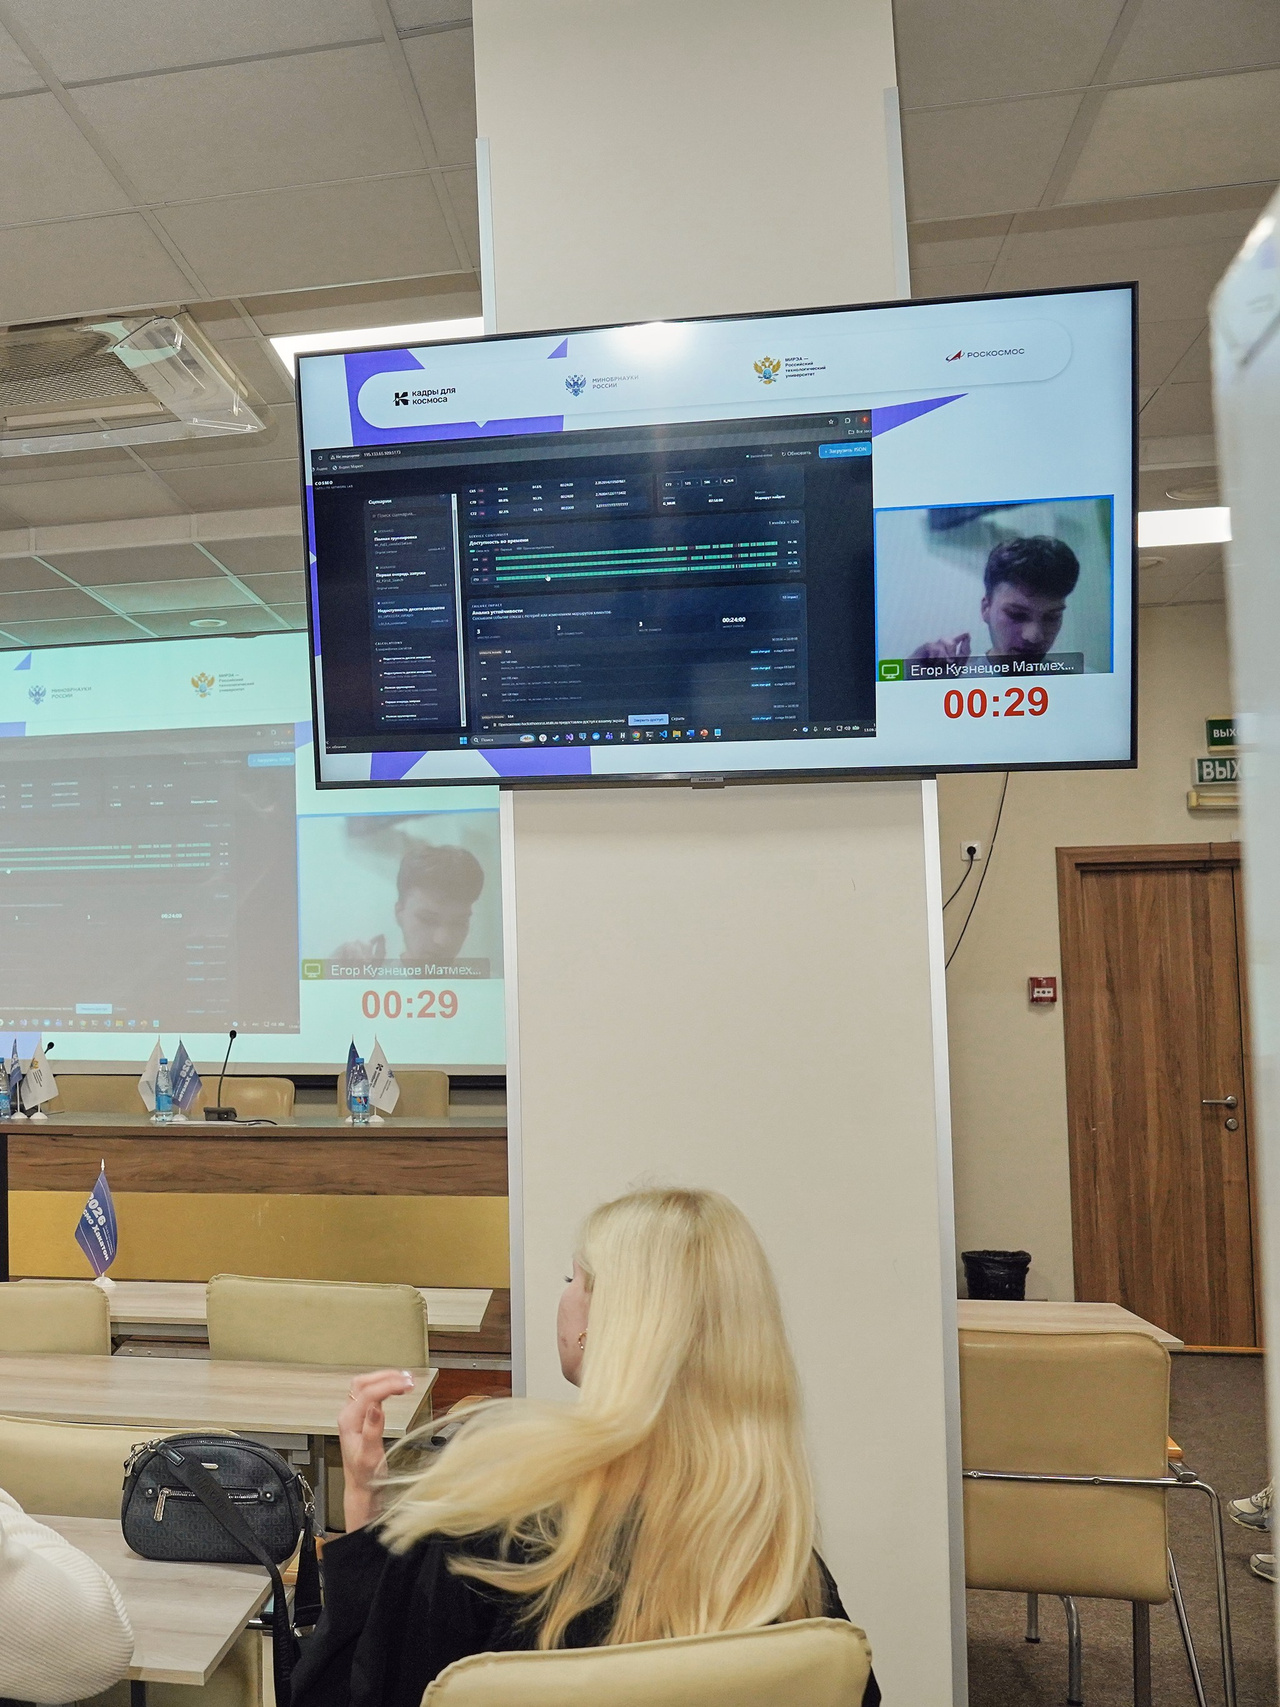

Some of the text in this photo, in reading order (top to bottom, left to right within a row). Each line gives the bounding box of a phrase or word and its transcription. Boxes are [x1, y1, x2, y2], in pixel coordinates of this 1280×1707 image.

[967, 348, 1025, 358] РОСКОСМОС
[592, 375, 639, 383] МИНОБРНАУКИ
[412, 387, 456, 398] кадры для
[412, 397, 448, 405] космоса
[911, 665, 943, 677] Егор
[946, 662, 1010, 677] Кузнецов
[51, 686, 92, 694] МИНОБРНАУКИ
[943, 686, 1049, 719] 00:29
[1213, 728, 1238, 738] ВЫХ
[331, 964, 360, 976] Егор
[363, 963, 421, 977] Кузнецов
[362, 989, 458, 1019] 00:29
